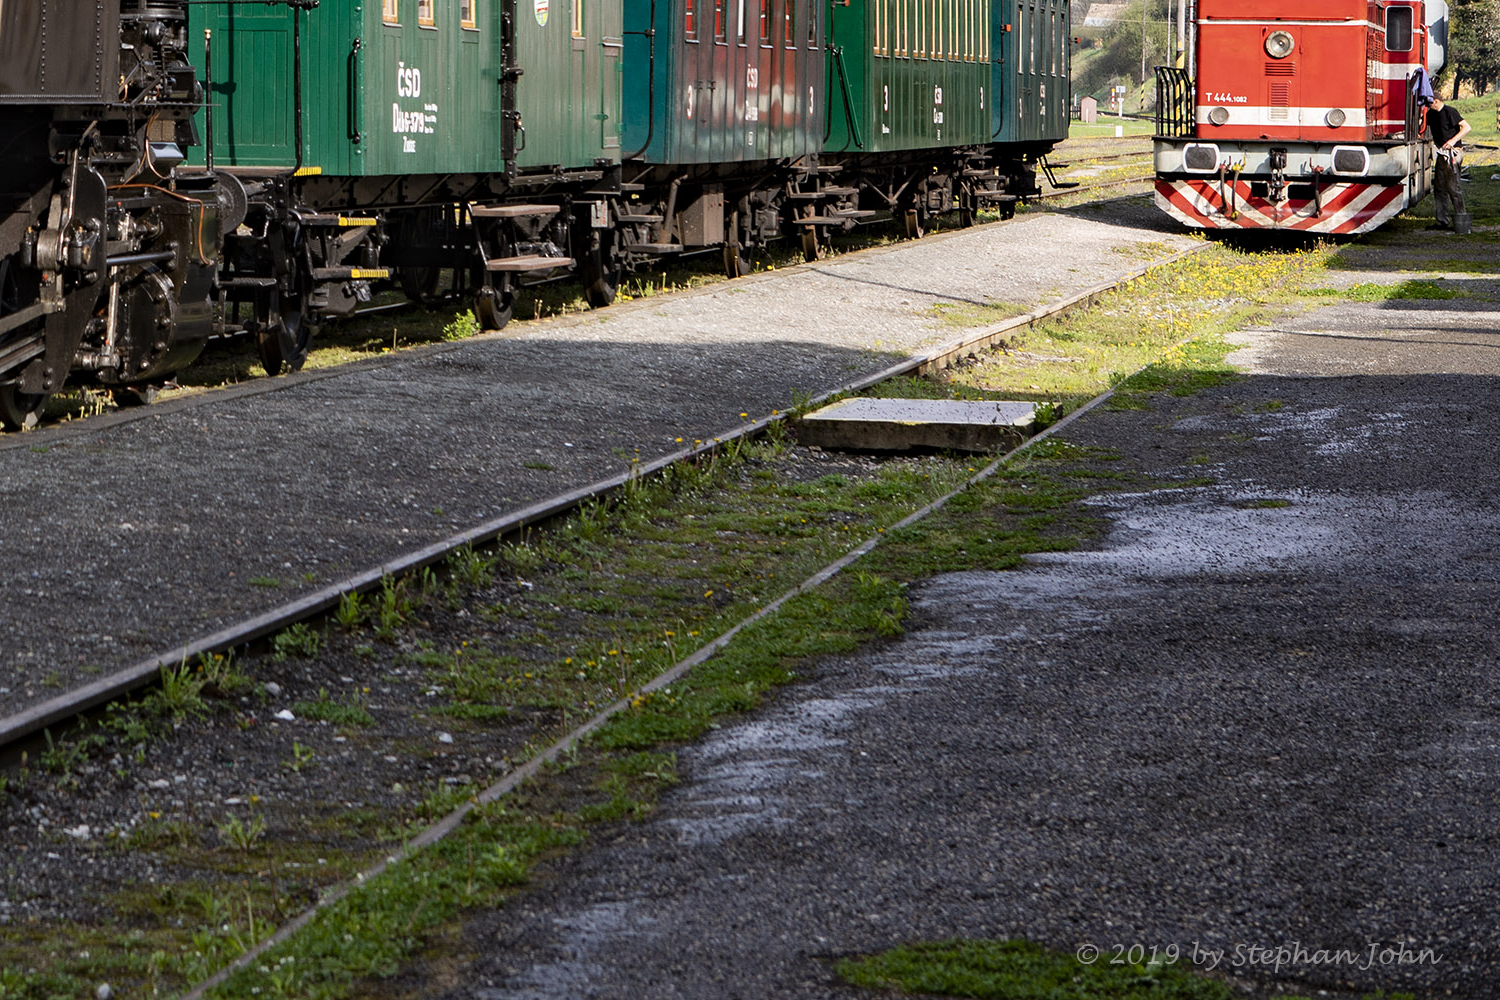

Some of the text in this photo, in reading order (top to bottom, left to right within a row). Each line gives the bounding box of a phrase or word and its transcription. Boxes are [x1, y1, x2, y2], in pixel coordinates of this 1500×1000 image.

[398, 62, 421, 98] ČSD
[746, 63, 758, 88] ČSD
[687, 85, 693, 118] 3
[1205, 92, 1213, 102] T
